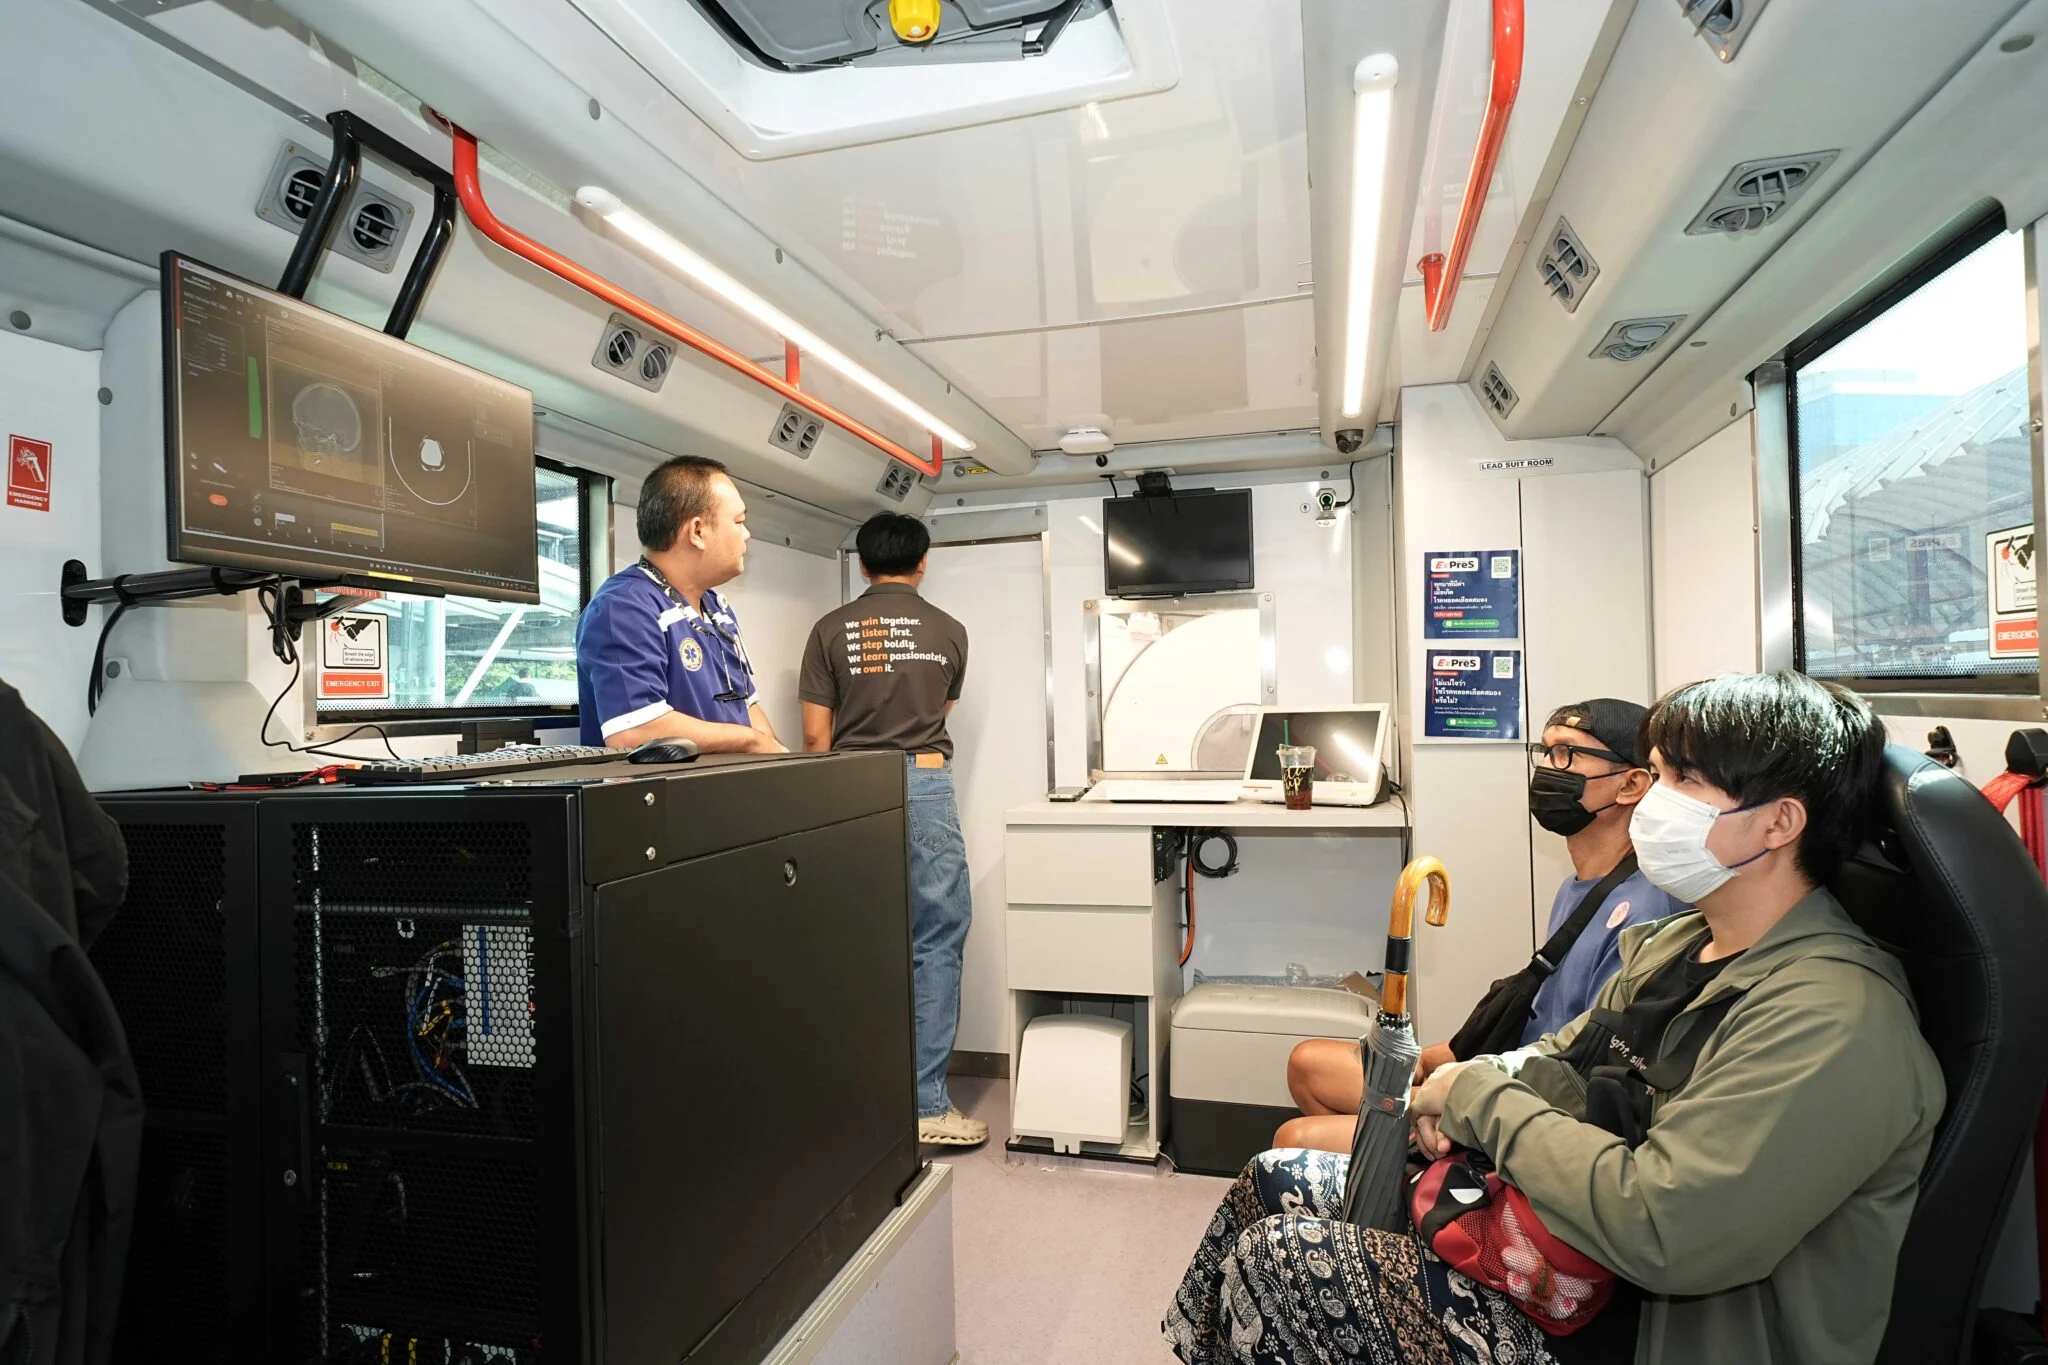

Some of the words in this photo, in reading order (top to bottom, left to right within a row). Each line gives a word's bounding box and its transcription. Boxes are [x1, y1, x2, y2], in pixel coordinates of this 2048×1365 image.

[1527, 459, 1552, 467] ROOM
[9, 491, 48, 501] EMERGENCY
[1435, 560, 1475, 569] ExPreS
[845, 620, 860, 629] We
[861, 617, 878, 626] win
[880, 617, 921, 627] together.
[846, 631, 860, 640] We
[862, 628, 888, 638] listen
[890, 628, 913, 638] first.
[847, 643, 861, 651] We
[862, 641, 883, 650] step
[884, 640, 918, 650] boldly.
[847, 654, 861, 663] We
[863, 652, 888, 662] learn
[889, 651, 948, 665] passionately.
[1437, 659, 1477, 668] ExPreS
[863, 665, 883, 674] own
[884, 664, 895, 672] it.
